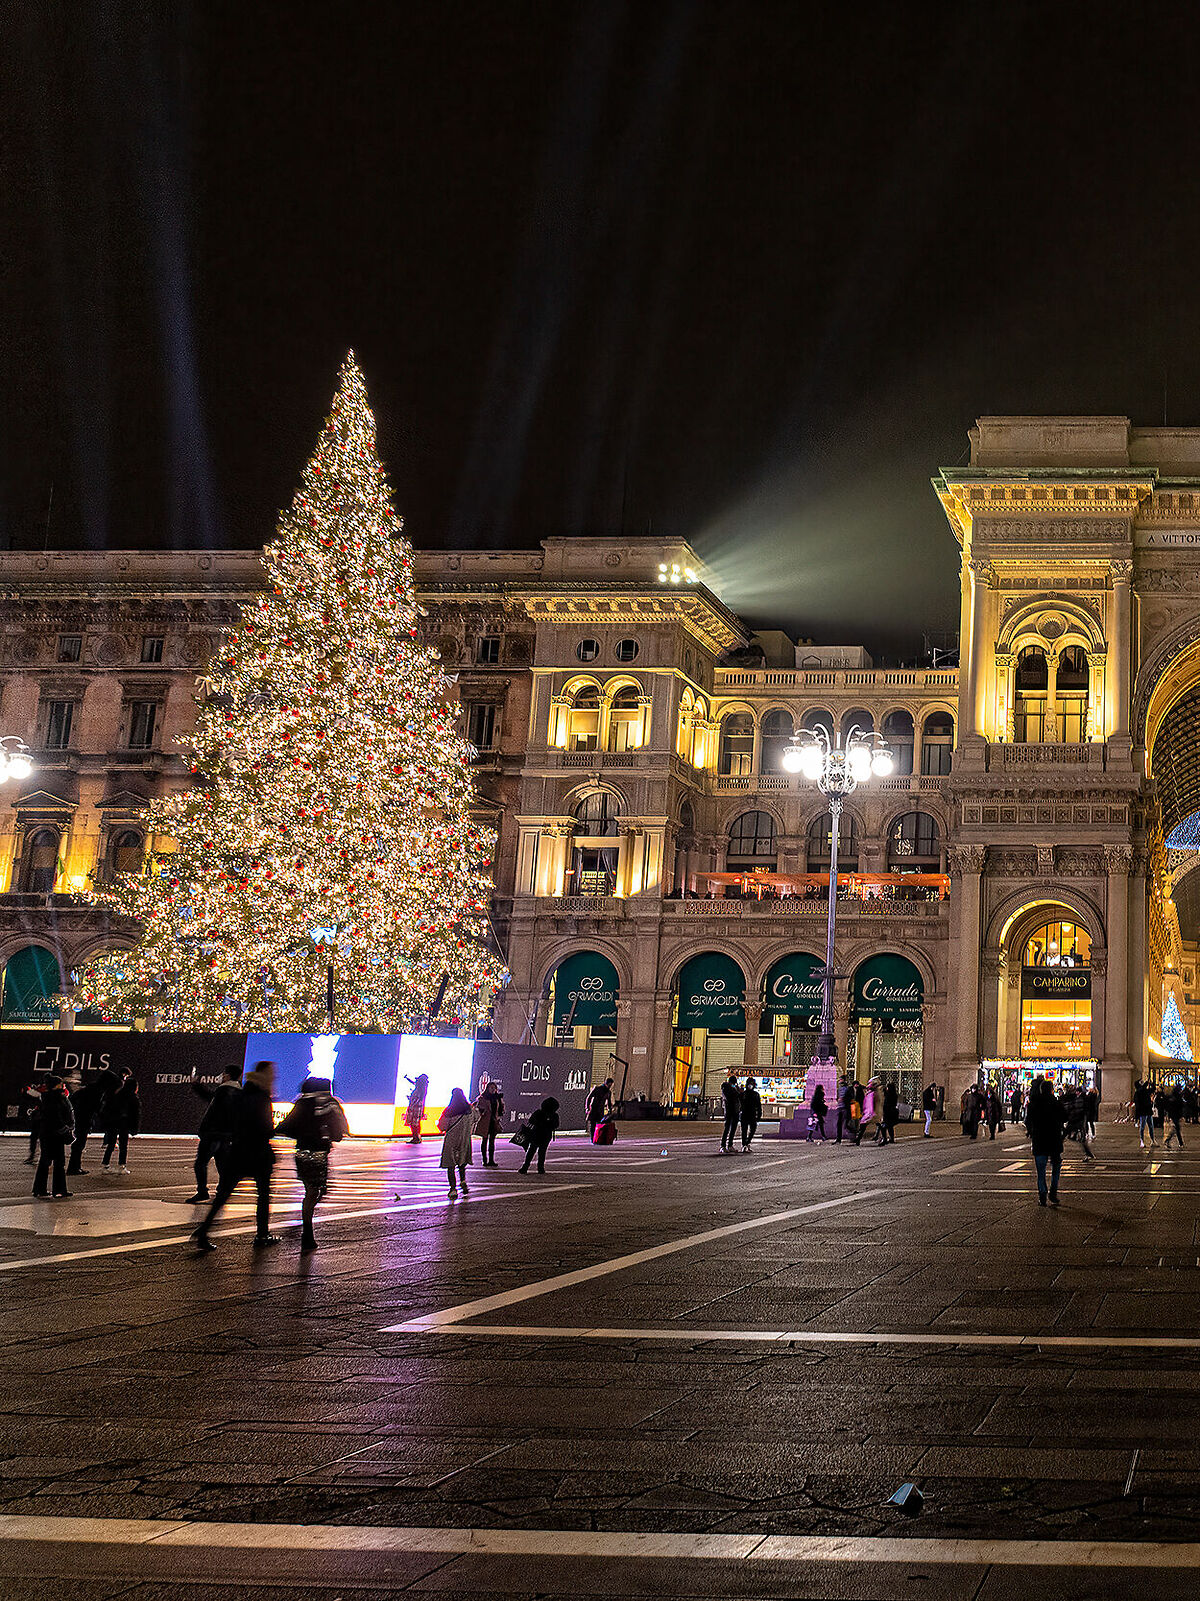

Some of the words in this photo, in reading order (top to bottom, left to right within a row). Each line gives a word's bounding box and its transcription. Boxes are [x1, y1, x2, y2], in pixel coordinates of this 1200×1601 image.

[1147, 534, 1156, 544] A
[1032, 976, 1088, 988] CAMPARINO
[862, 977, 919, 1001] Currado
[568, 991, 614, 1002] GRIMOLDI
[690, 994, 739, 1006] GRIMOLDI
[64, 1052, 111, 1071] DILS
[155, 1073, 222, 1084] YESMANO
[532, 1065, 551, 1081] DILS
